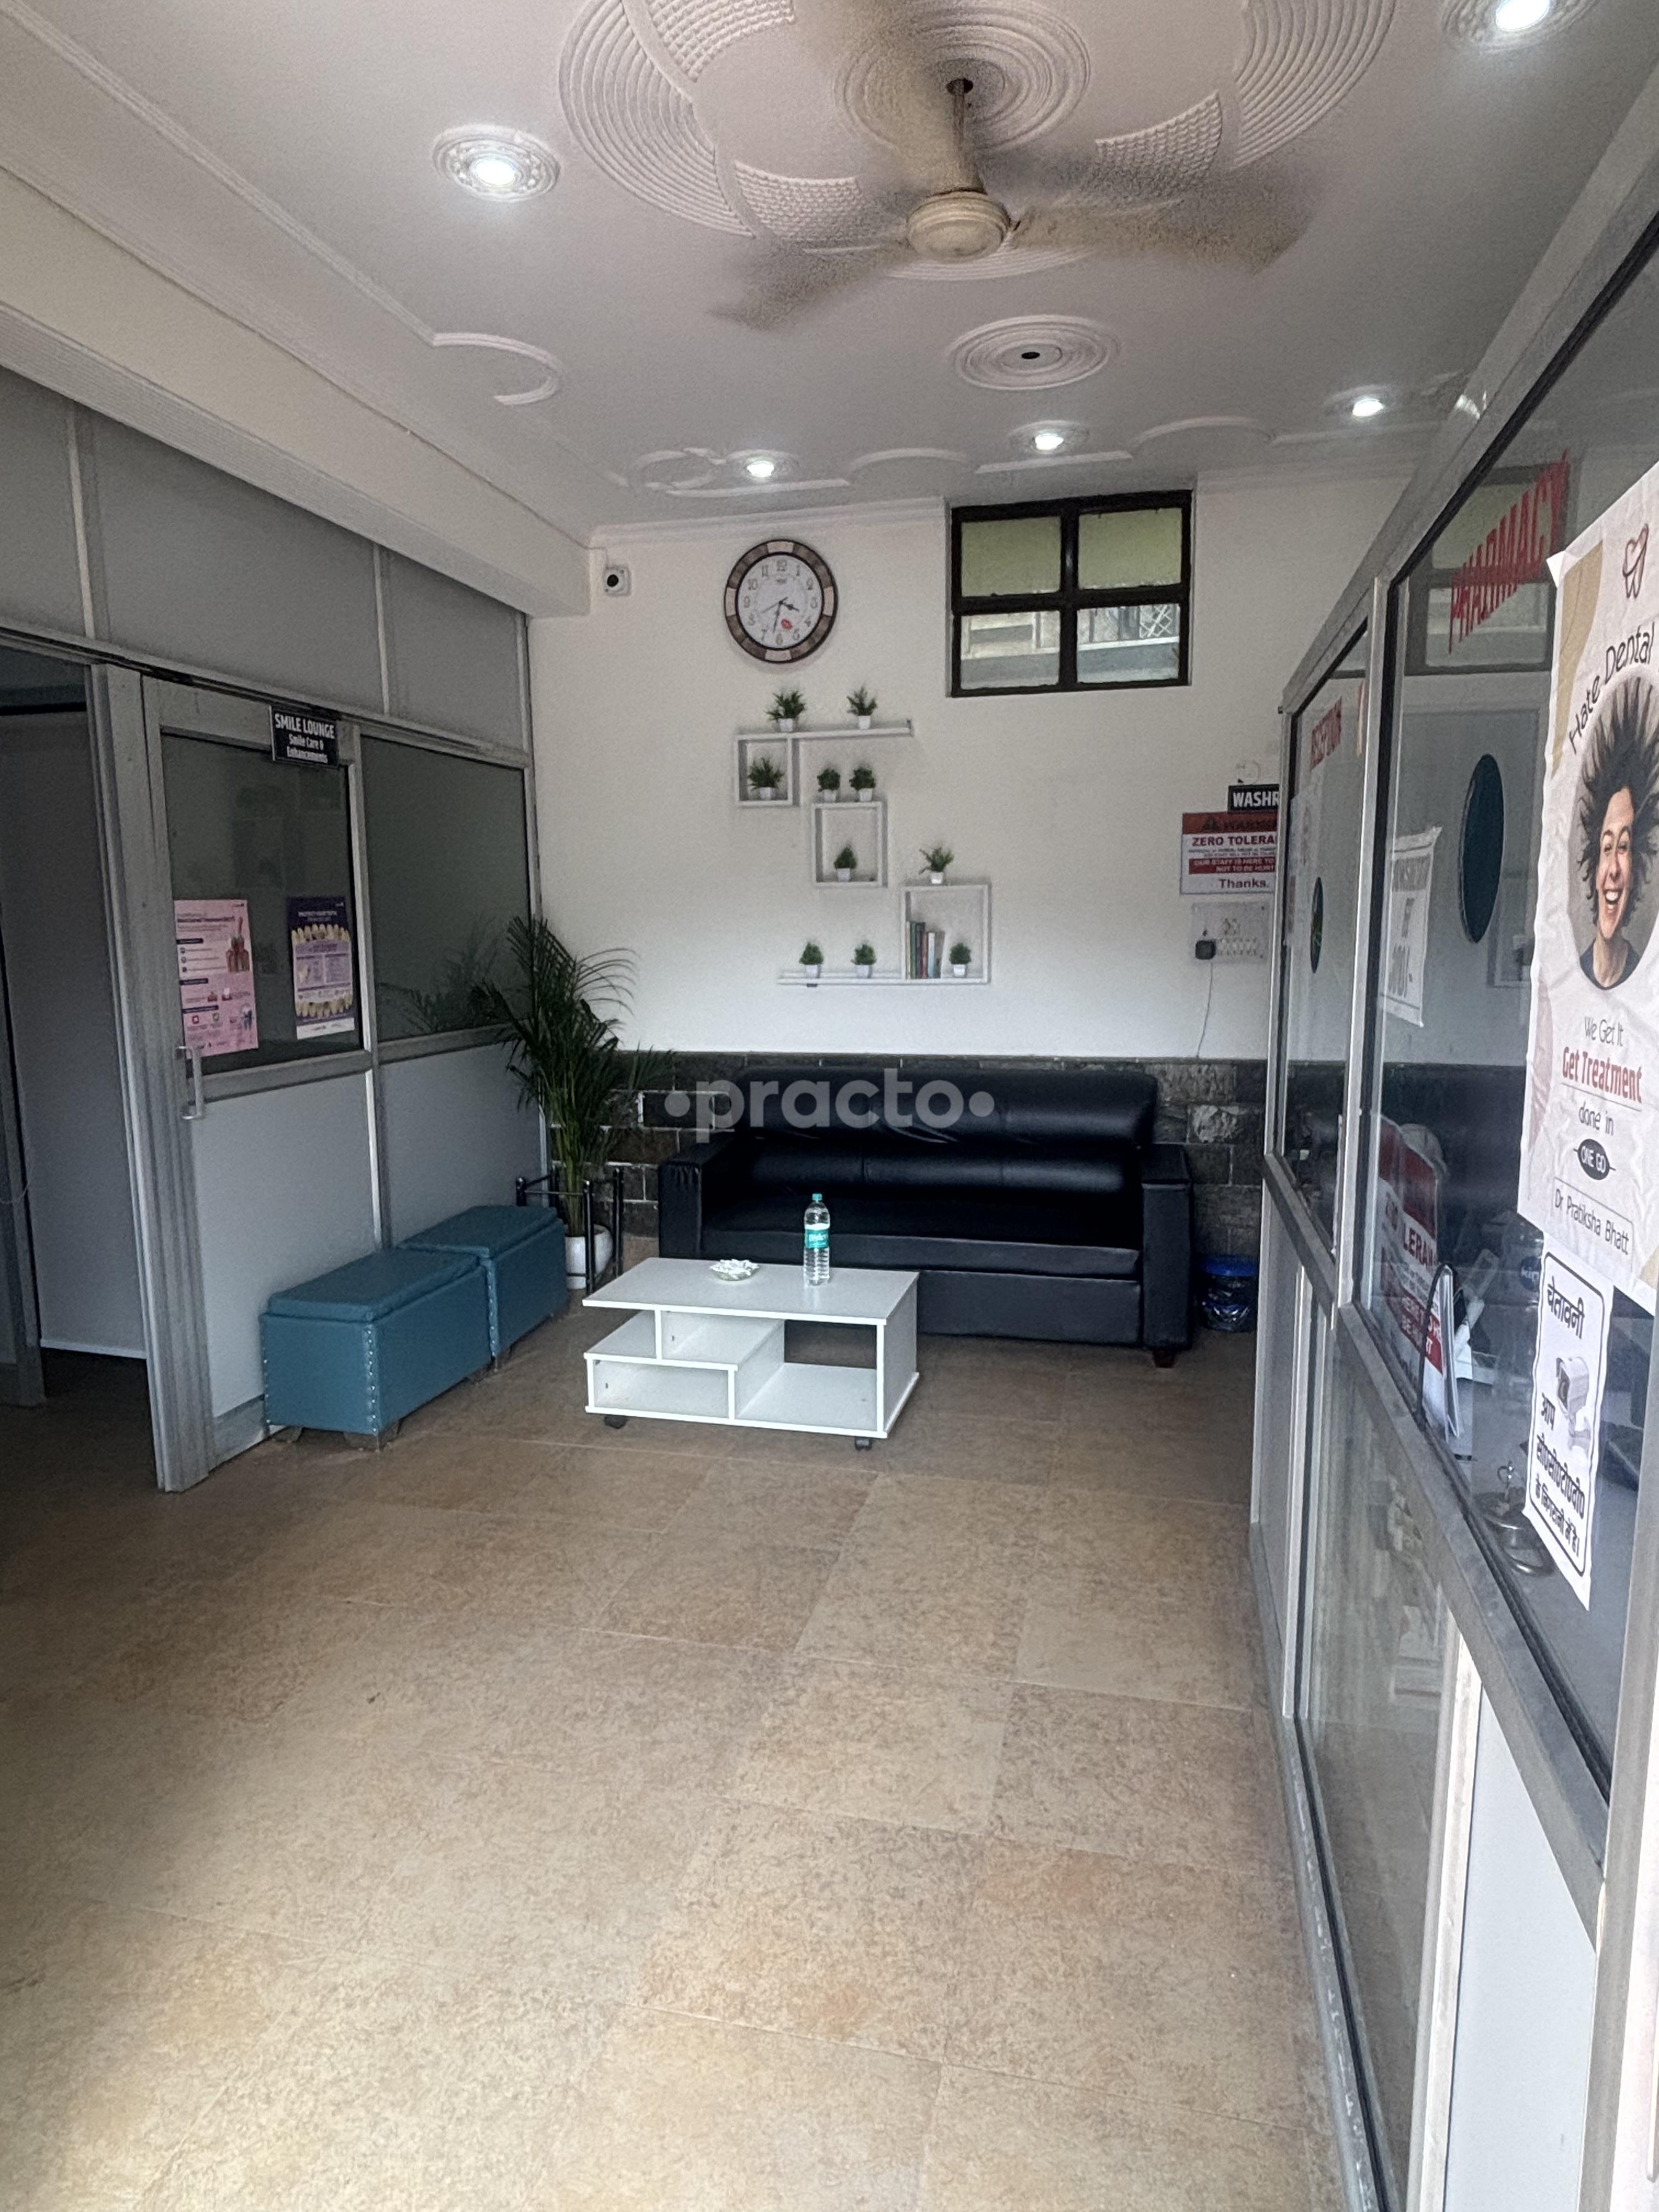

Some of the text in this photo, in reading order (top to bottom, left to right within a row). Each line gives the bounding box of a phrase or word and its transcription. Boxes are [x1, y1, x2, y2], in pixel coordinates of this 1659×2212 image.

[777, 560, 787, 572] 12
[748, 578, 758, 590] 10
[1569, 622, 1655, 755] Hate Dental
[275, 713, 335, 739] SMILE LOUNGE
[1192, 835, 1277, 847] ZERO TOLERA
[1584, 1017, 1623, 1047] We Get It
[1562, 1046, 1642, 1103] Get Treatment
[1578, 1101, 1614, 1136] done in
[1581, 1146, 1606, 1173] ONE GO
[1555, 1188, 1629, 1255] Dr Pratiksha Bhatt
[1548, 1276, 1585, 1339] चेतावनी
[1541, 1392, 1555, 1431] आप
